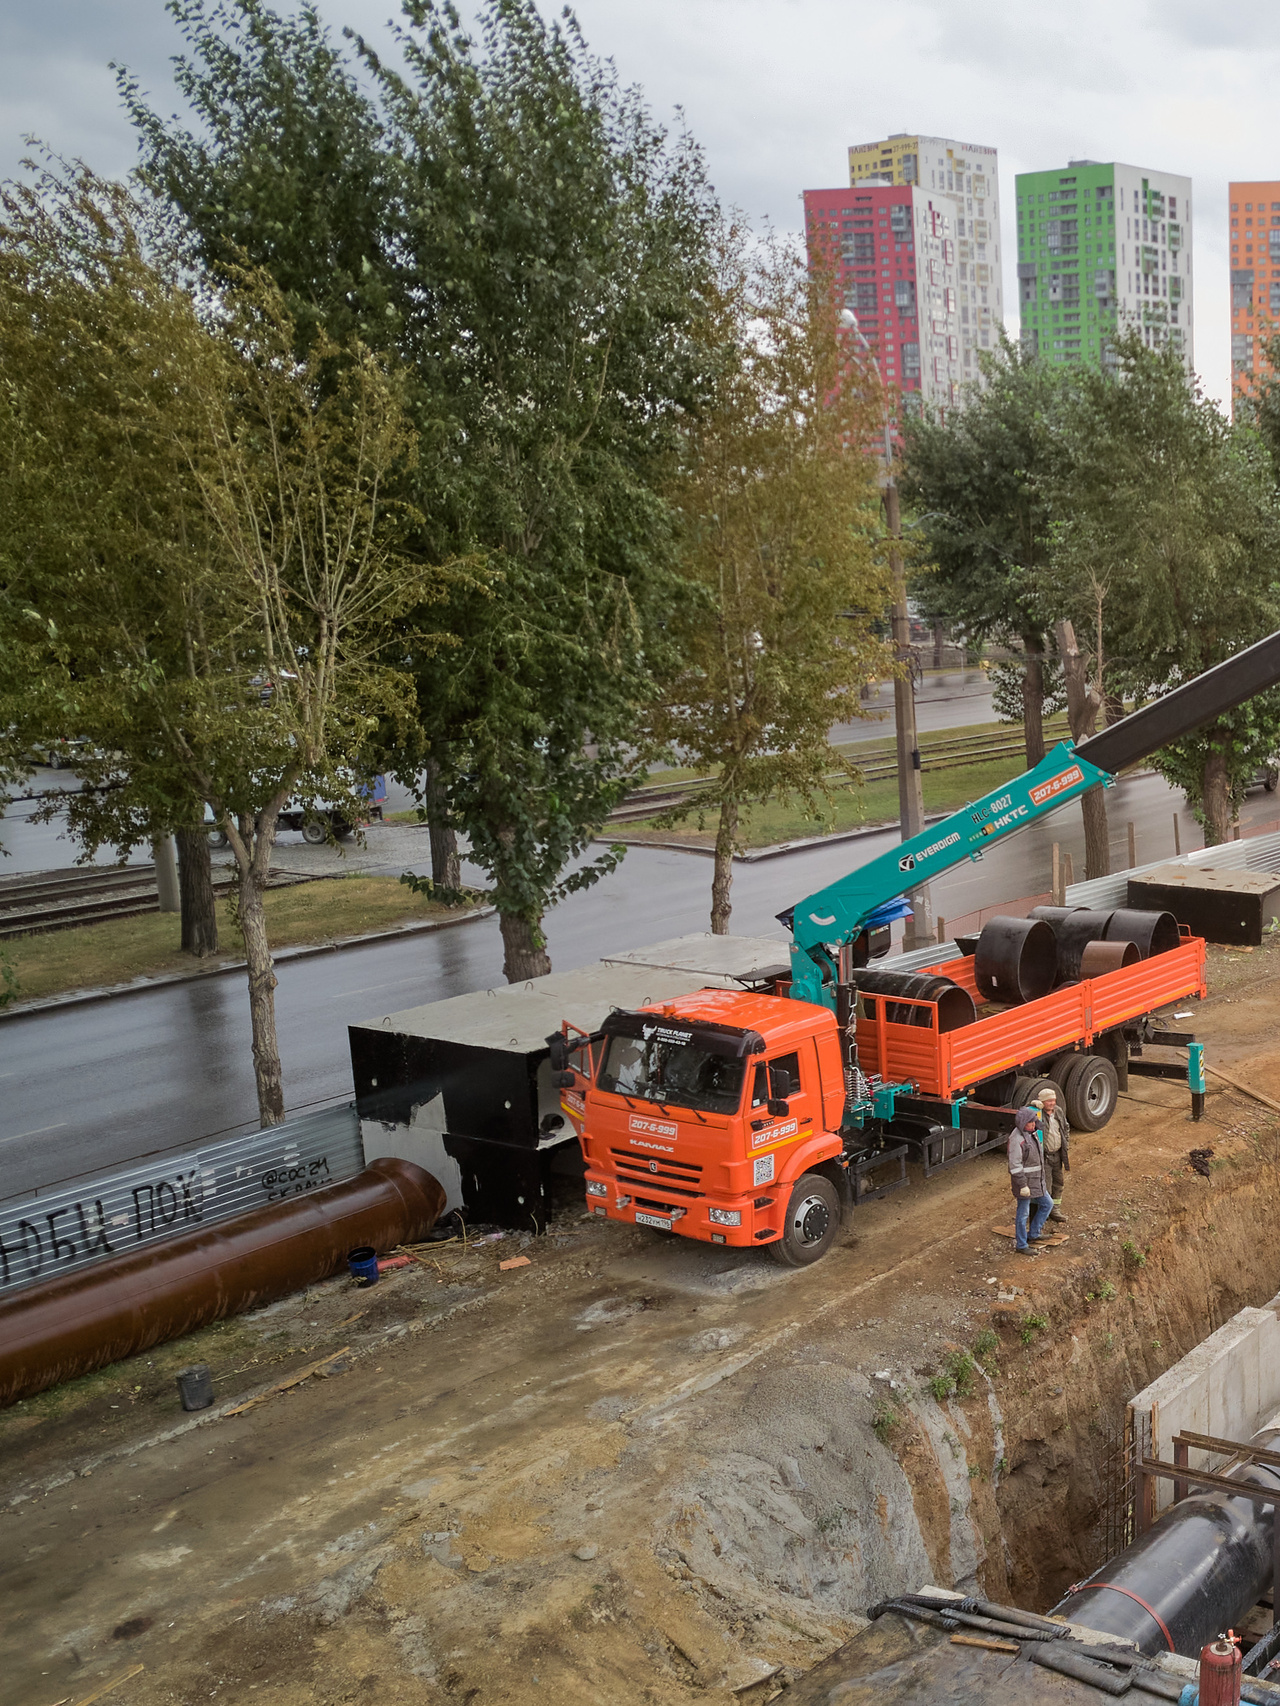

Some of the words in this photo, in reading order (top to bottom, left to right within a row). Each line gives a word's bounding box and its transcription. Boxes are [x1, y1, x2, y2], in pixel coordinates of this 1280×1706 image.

[1033, 769, 1080, 801] 207-6-999
[971, 794, 1012, 824] HLC-8027
[994, 804, 1028, 829] HKTC
[915, 832, 961, 862] EVERDIGM
[631, 1119, 676, 1136] 207-6-999
[754, 1122, 796, 1145] 207-6-999
[629, 1139, 675, 1153] KAMAZ
